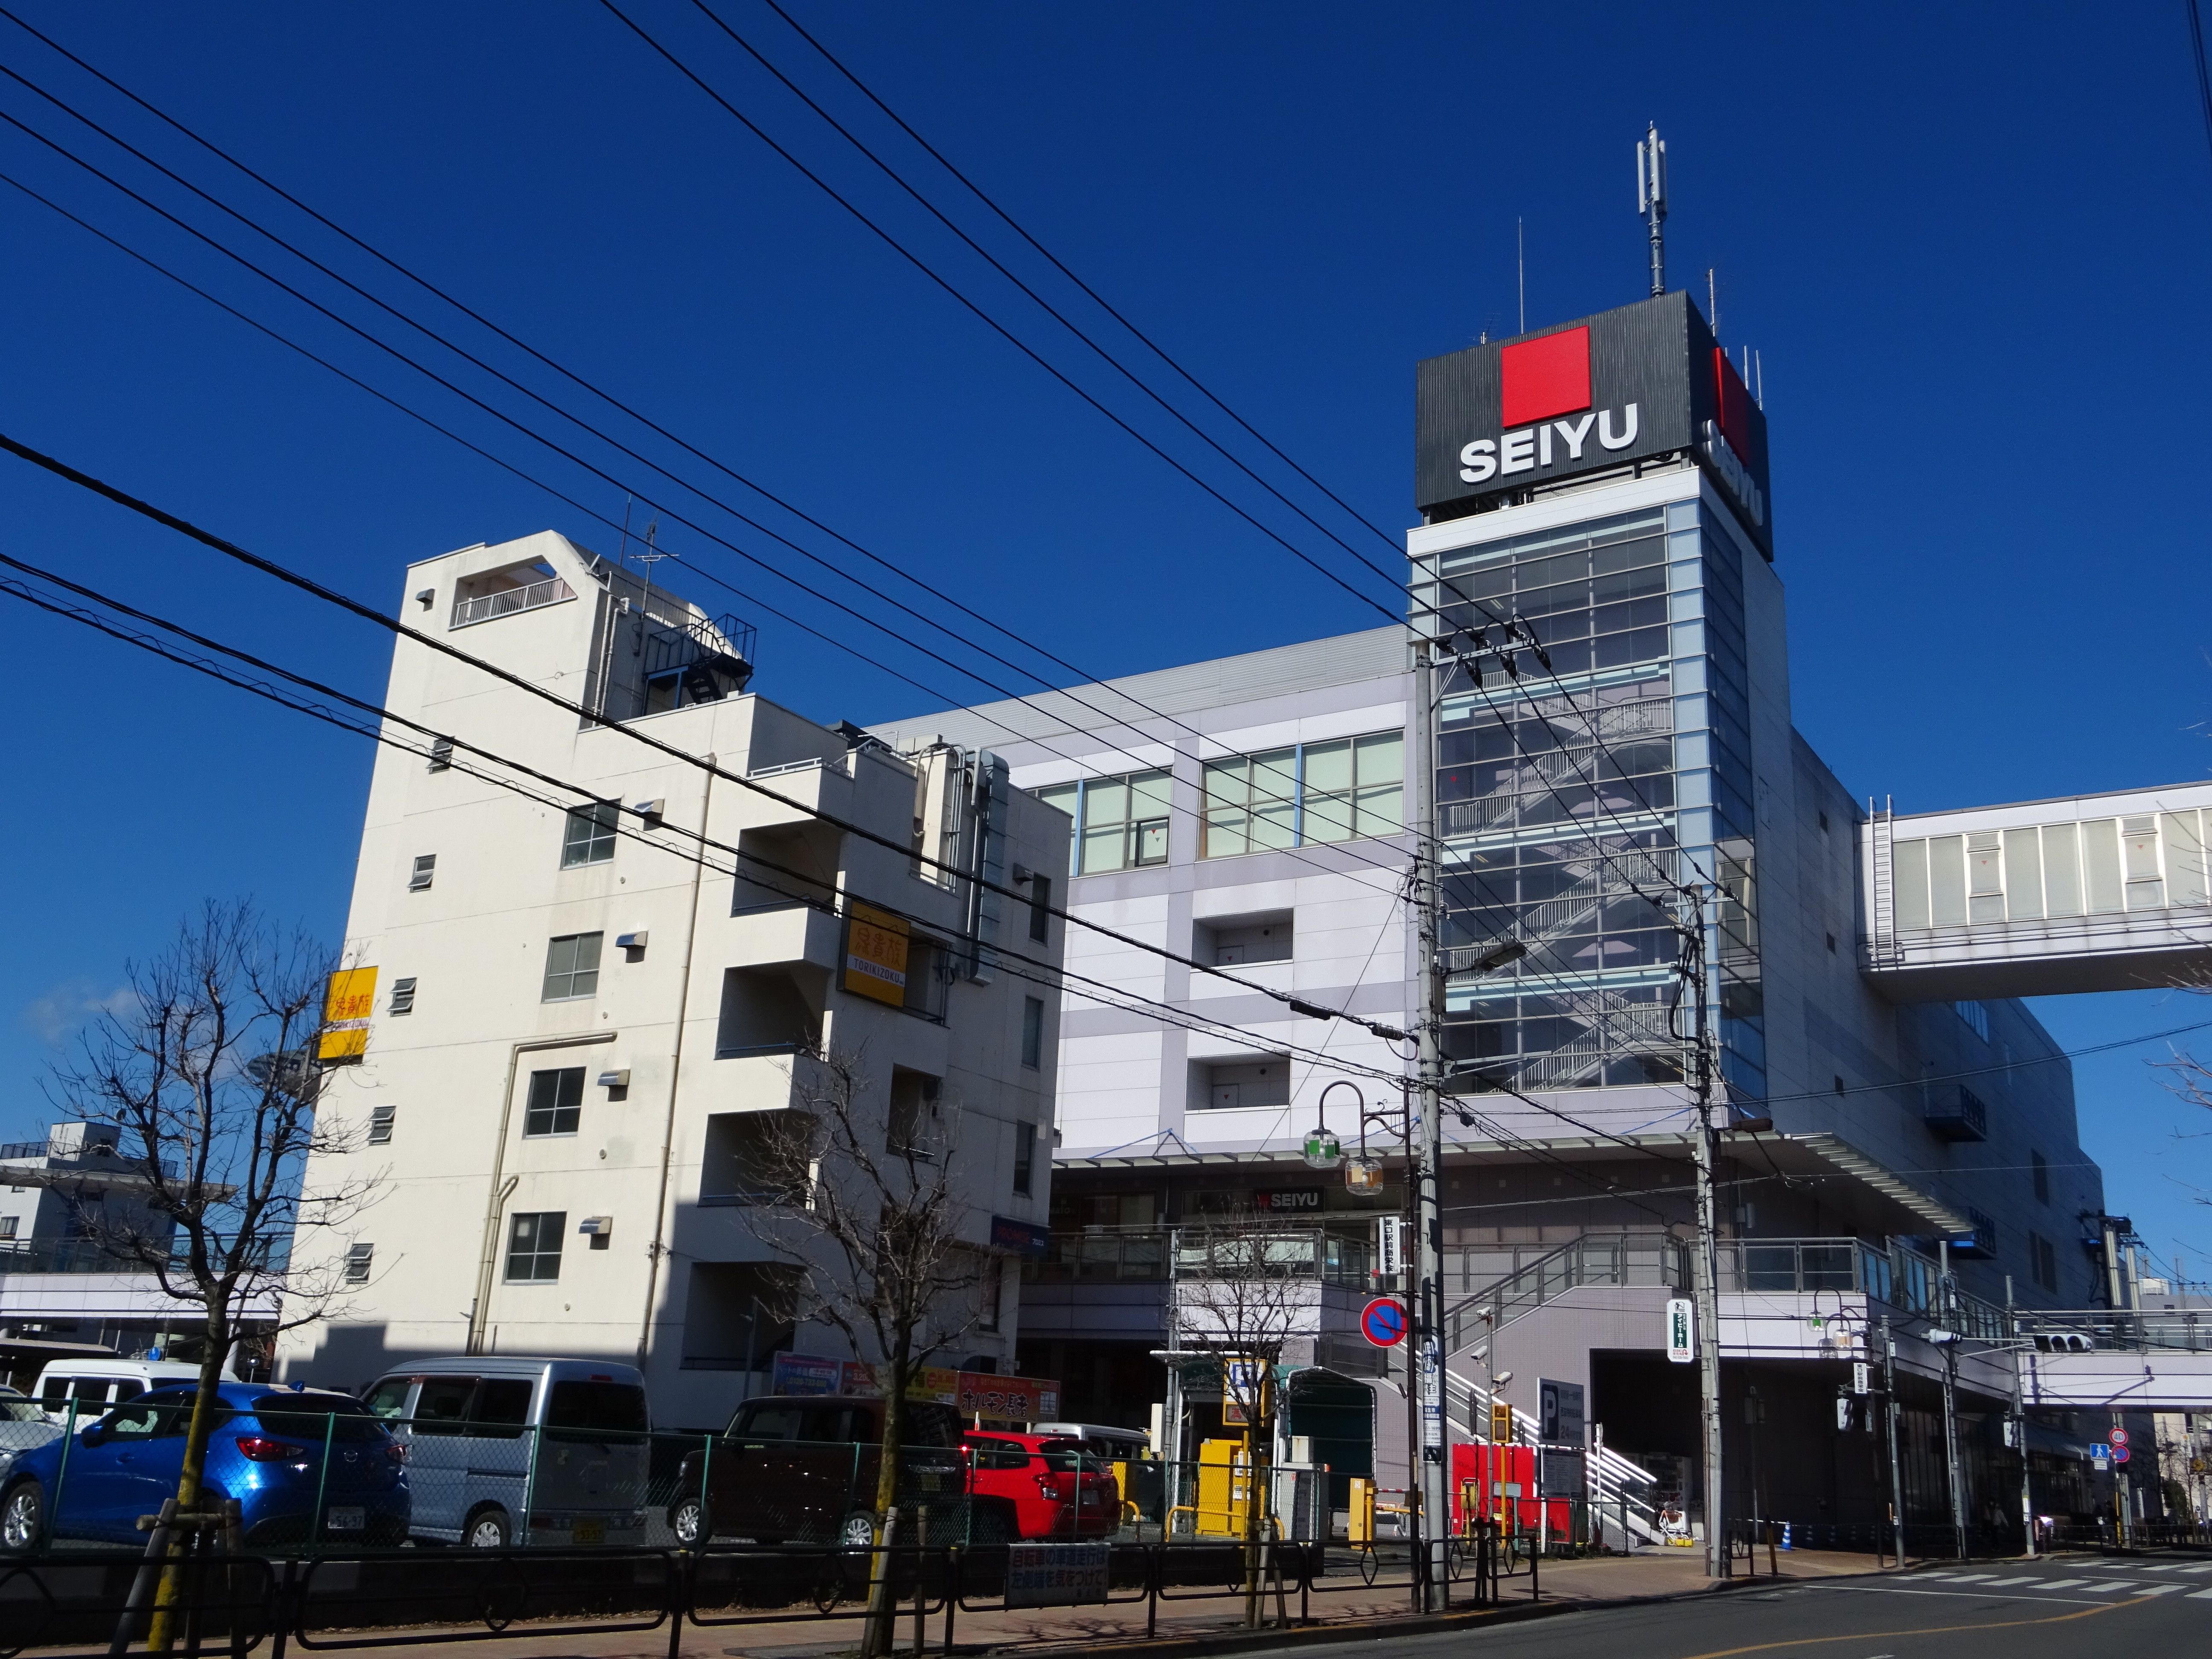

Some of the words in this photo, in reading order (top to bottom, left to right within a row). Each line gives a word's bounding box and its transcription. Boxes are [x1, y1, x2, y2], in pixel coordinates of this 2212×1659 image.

[1459, 403, 1638, 483] SEIYU
[853, 958, 900, 983] TORIKIZOKU
[1271, 1192, 1318, 1207] SEIYU
[1384, 1219, 1394, 1272] 東口駅前商栄会
[961, 1388, 1029, 1418] ホルモン長者
[1544, 1390, 1556, 1433] P
[1013, 1548, 1106, 1567] 自転車の車道走行は
